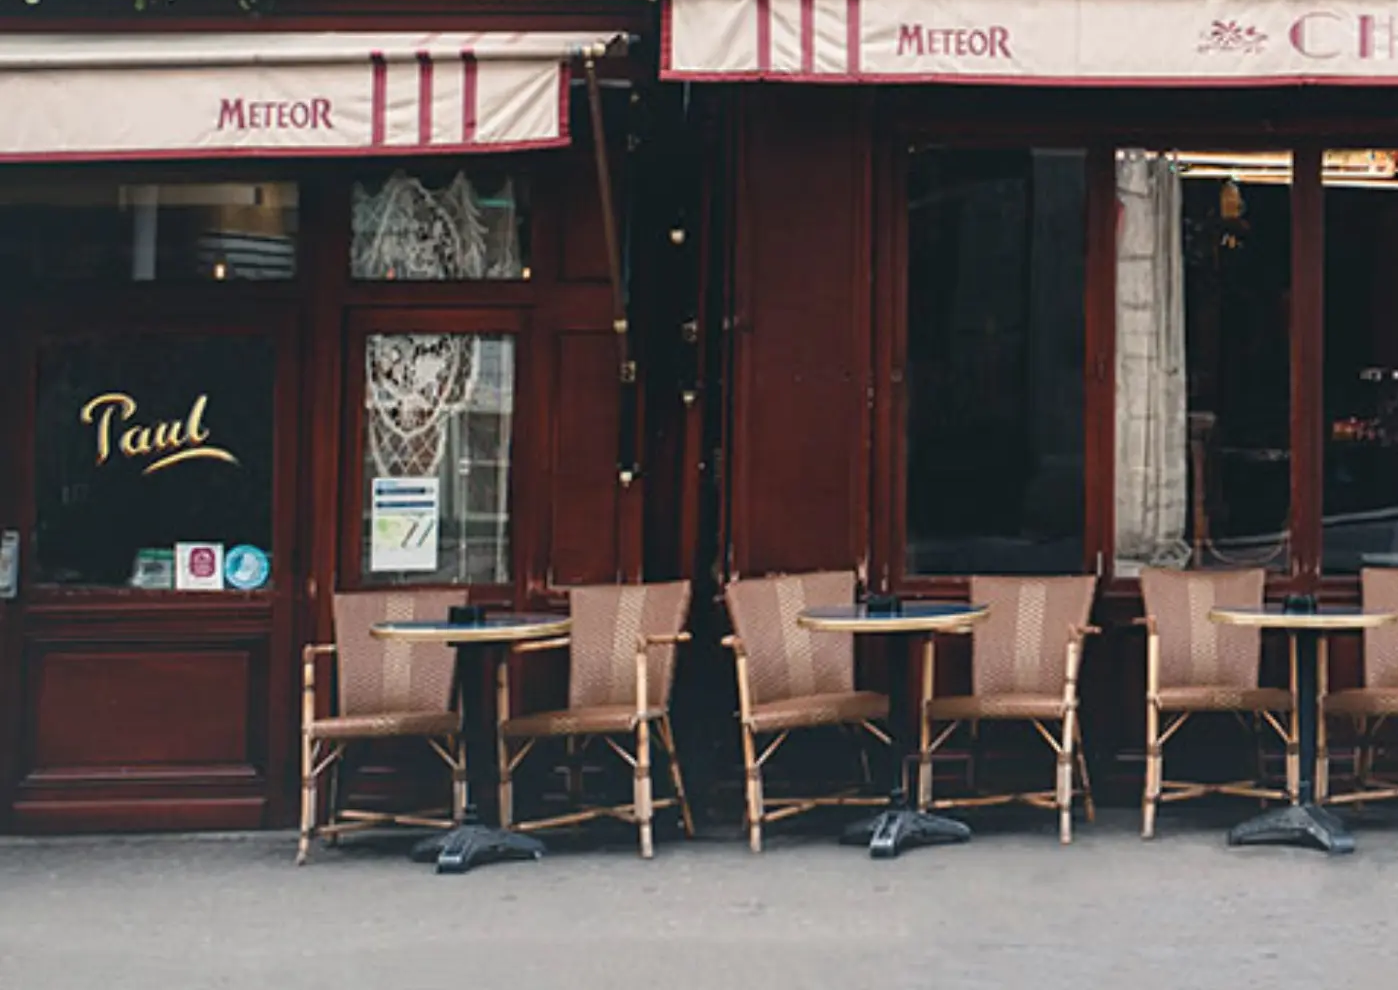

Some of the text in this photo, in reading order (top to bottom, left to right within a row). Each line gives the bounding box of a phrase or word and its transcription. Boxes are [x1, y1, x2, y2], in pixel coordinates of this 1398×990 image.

[896, 23, 1012, 58] METEOR
[217, 98, 334, 129] METEOR
[80, 392, 210, 467] Paul
